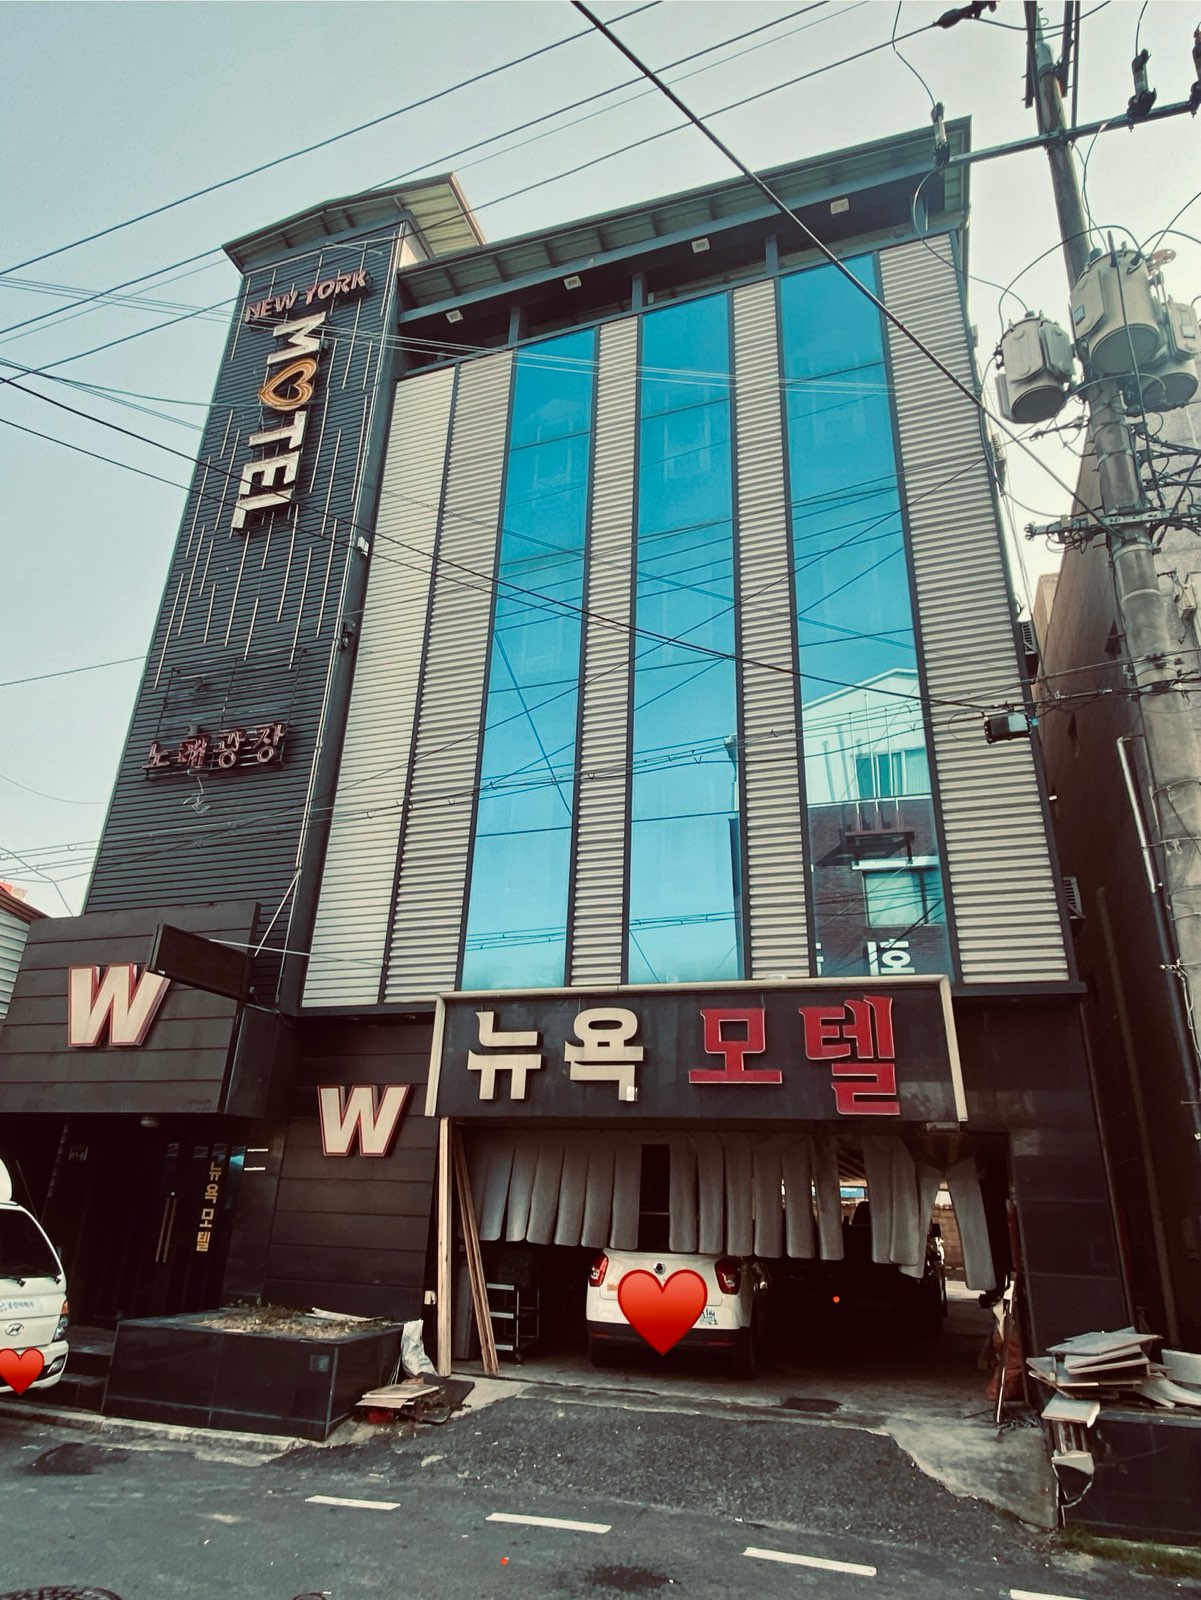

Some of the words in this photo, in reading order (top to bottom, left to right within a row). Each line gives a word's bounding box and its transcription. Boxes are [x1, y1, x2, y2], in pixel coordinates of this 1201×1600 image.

[245, 291, 298, 322] NEW
[305, 270, 368, 306] YORK
[67, 963, 170, 1047] W
[467, 1008, 643, 1101] 뉴욕
[688, 995, 901, 1116] 모텔
[317, 1084, 411, 1157] W
